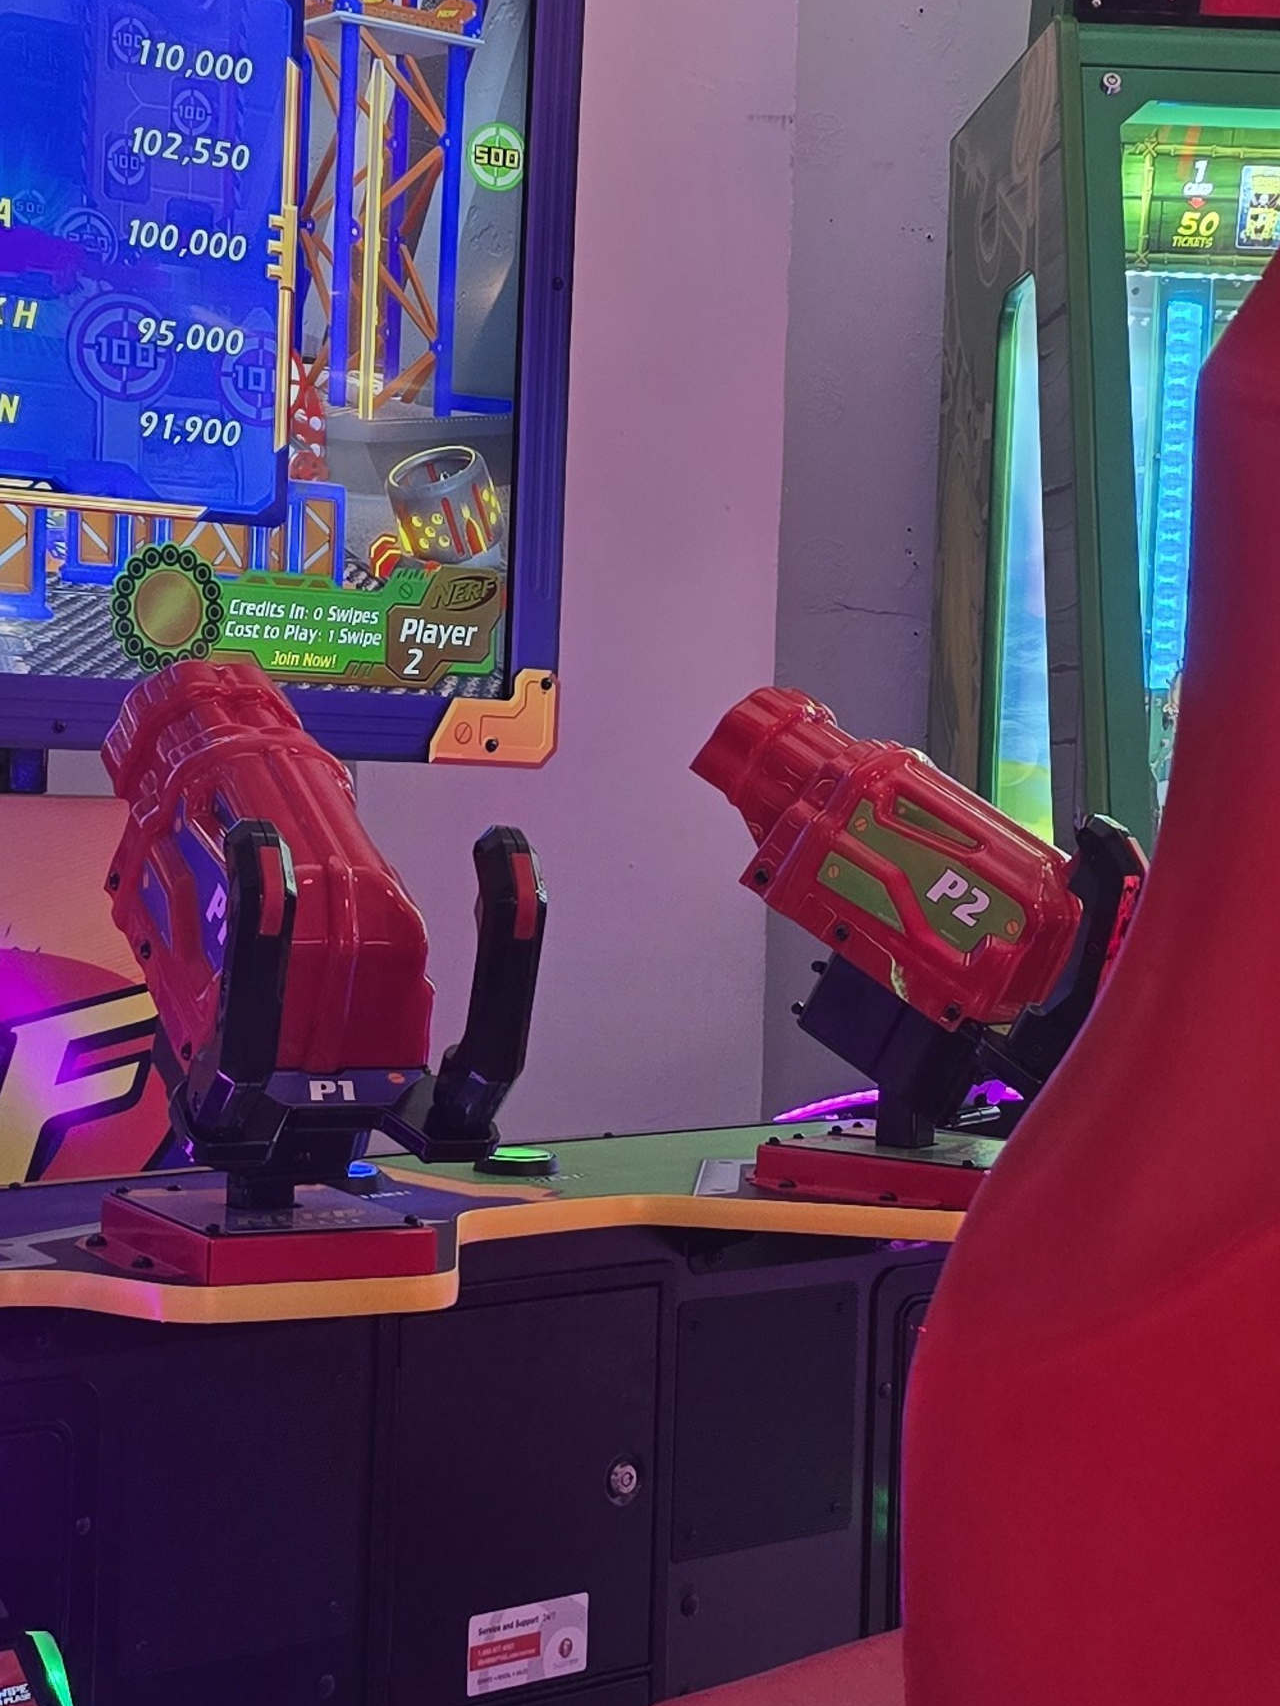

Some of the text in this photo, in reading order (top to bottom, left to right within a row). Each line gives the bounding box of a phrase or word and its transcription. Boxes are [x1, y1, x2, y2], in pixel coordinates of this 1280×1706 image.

[139, 38, 254, 85] 110,000
[132, 127, 251, 172] 102,550
[474, 145, 520, 170] 500
[1194, 160, 1208, 183] 1
[1177, 211, 1220, 237] 50
[129, 218, 247, 262] 100,000
[14, 300, 38, 330] H
[137, 317, 244, 356] 95,000
[139, 411, 241, 447] 91,900
[430, 578, 496, 610] NERF
[229, 598, 286, 618] Credits
[289, 603, 308, 620] In:
[327, 605, 380, 625] Swipes
[225, 620, 261, 639] Cost
[264, 624, 280, 639] to
[283, 624, 322, 645] Play:
[337, 629, 382, 647] Swipe
[399, 616, 478, 649] Player
[271, 650, 337, 668] Join Now!
[403, 649, 424, 675] 2
[925, 868, 991, 928] P2
[308, 1079, 356, 1101] P1
[502, 1621, 514, 1631] and
